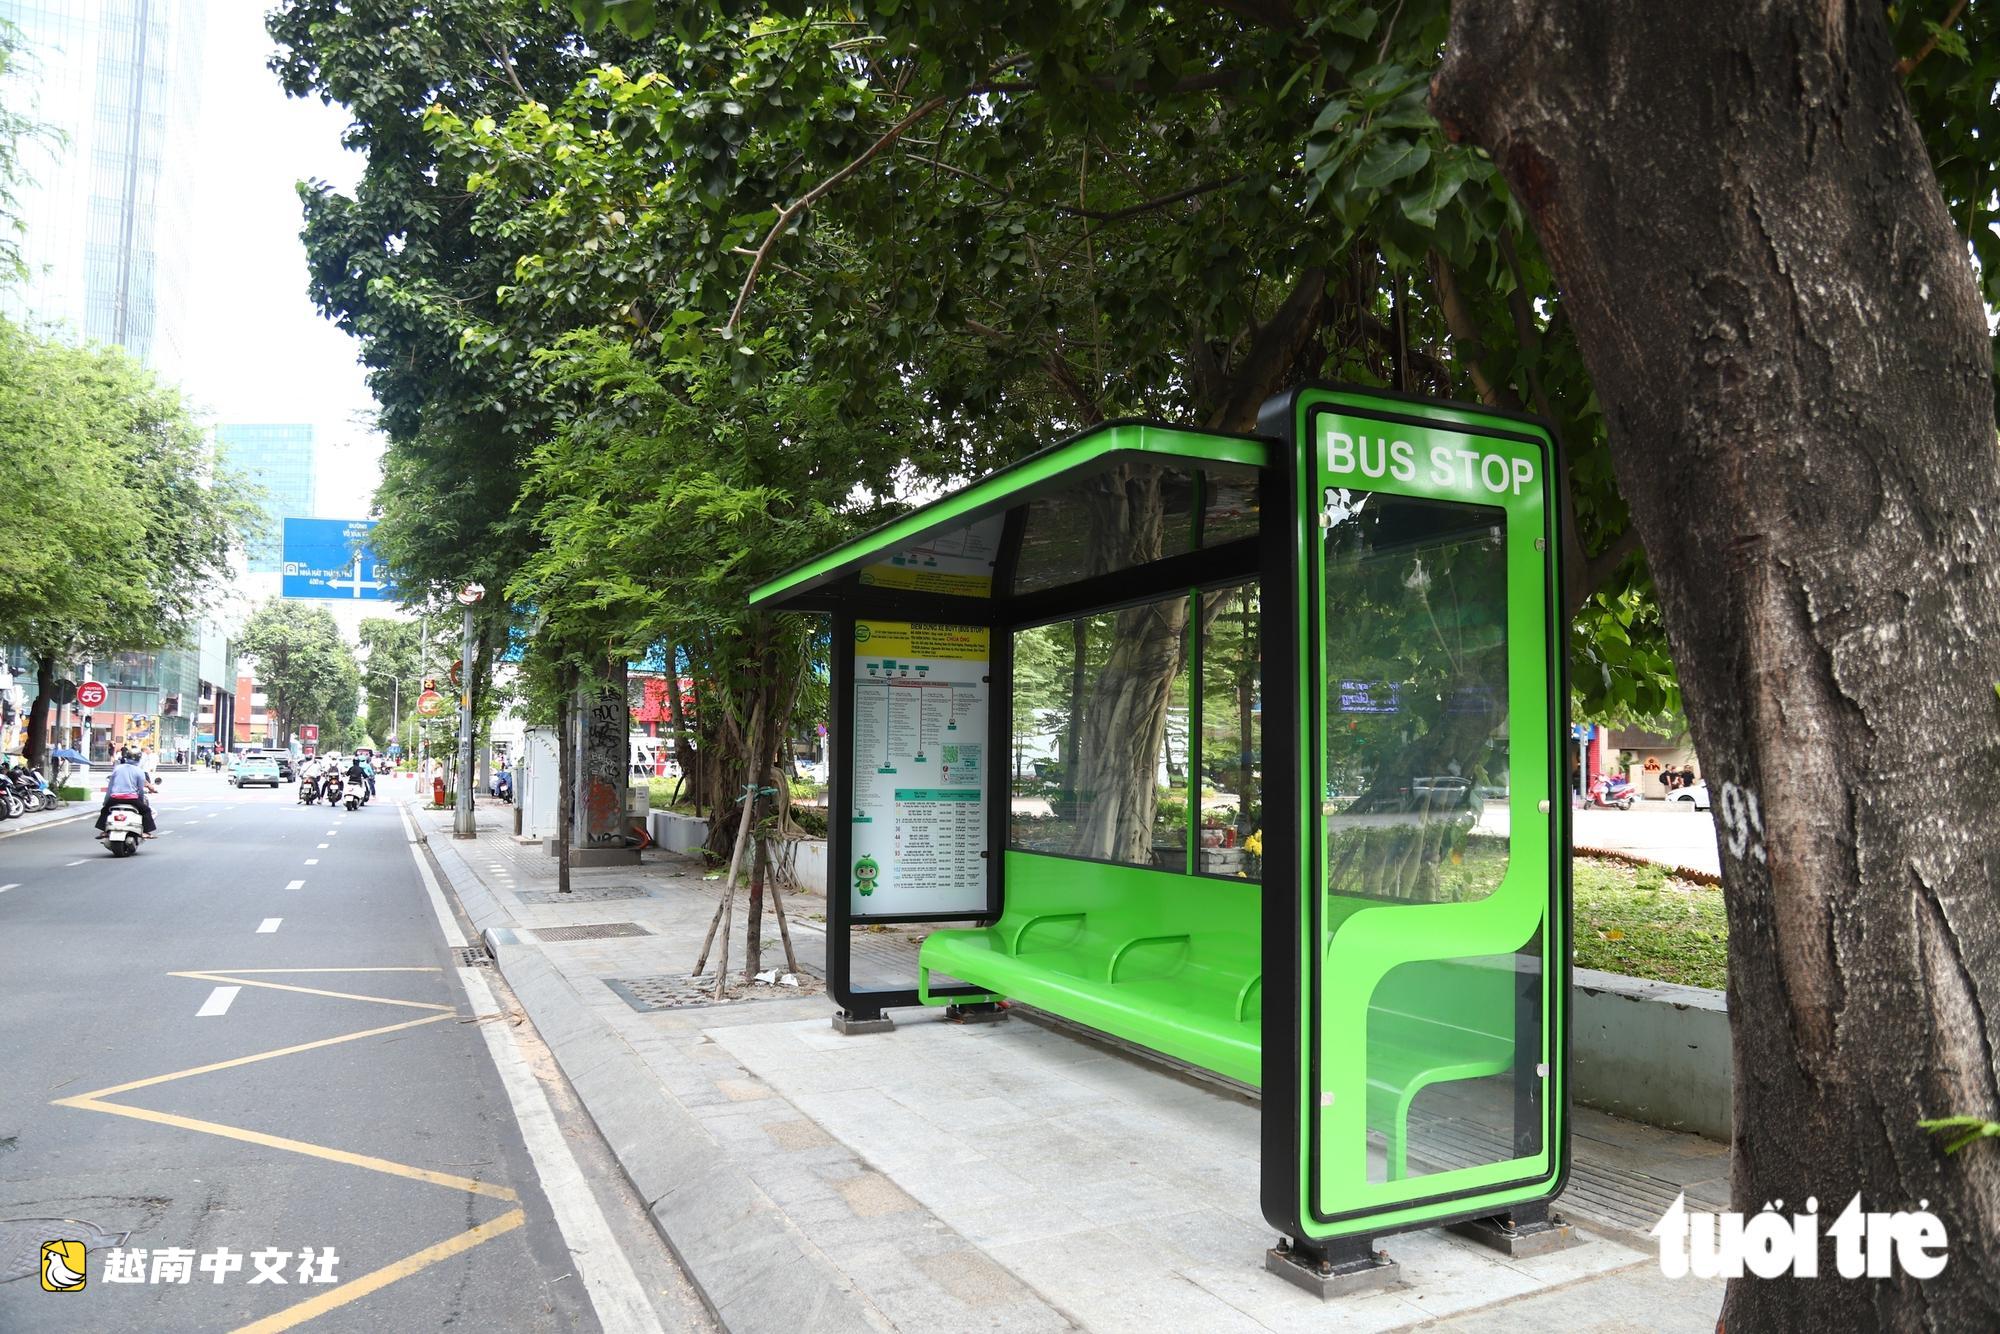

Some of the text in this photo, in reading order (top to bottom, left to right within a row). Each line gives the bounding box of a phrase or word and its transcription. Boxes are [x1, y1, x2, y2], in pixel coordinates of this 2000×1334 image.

[1326, 431, 1534, 496] BUS STOP
[81, 691, 102, 702] 5G
